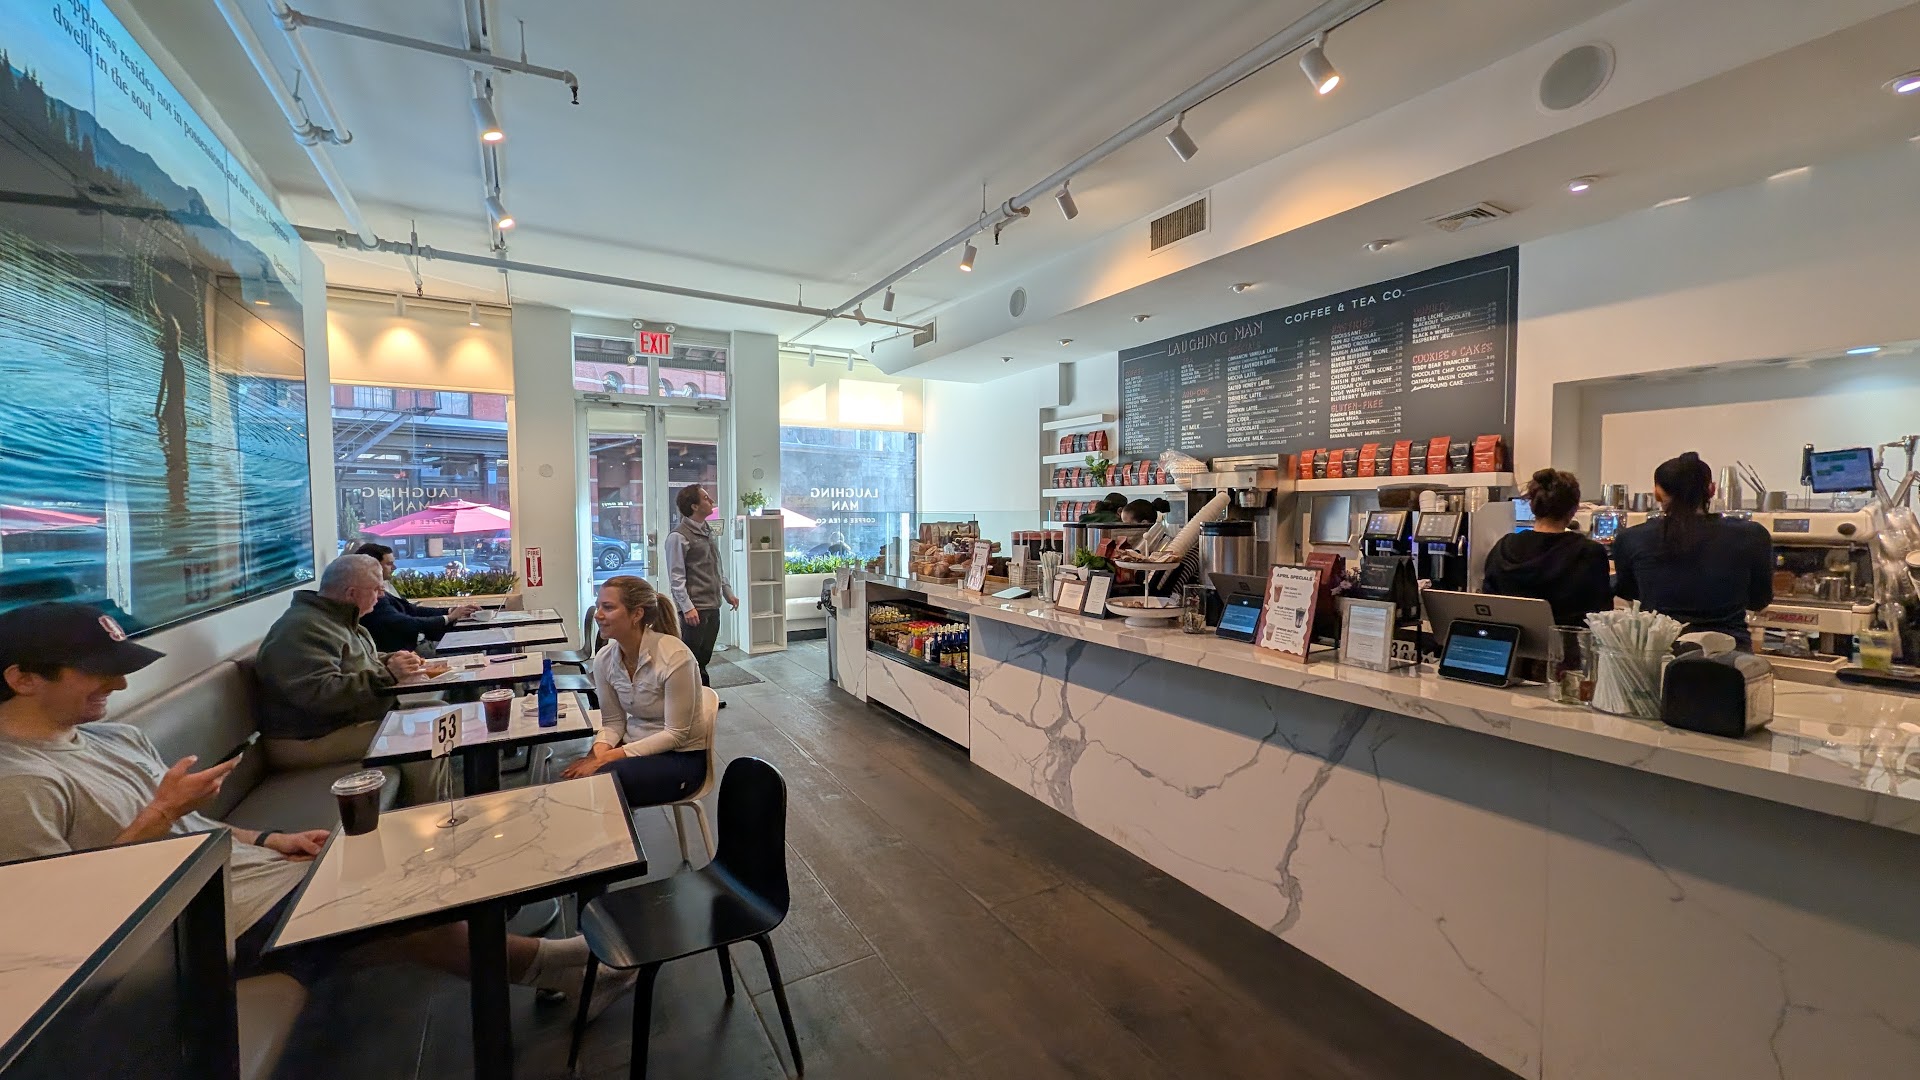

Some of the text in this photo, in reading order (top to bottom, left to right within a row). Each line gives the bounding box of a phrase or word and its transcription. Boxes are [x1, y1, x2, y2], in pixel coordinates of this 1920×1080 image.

[53, 4, 152, 120] dwells in the soul
[119, 49, 155, 97] resides
[156, 90, 173, 116] not
[174, 104, 183, 127] in
[226, 168, 239, 188] and
[1285, 289, 1406, 325] COFFEE & TEA CO.
[1413, 311, 1471, 328] BLACKOUT CHOCOLATE
[1428, 312, 1443, 320] LECHE
[1168, 321, 1263, 357] LAUGHING MAN
[1331, 330, 1361, 340] CROISSANT
[1351, 332, 1376, 341] CHOCOLAT
[1413, 335, 1439, 344] RASPBERRY
[640, 331, 671, 355] EXIT
[1332, 337, 1380, 351] ALMOND CROISSANT
[1228, 353, 1248, 361] CINNAMON
[1412, 350, 1450, 364] COOKIES
[1460, 342, 1493, 356] CAKES
[1242, 362, 1263, 370] LAVENDER
[1331, 360, 1356, 368] BLUEBERRY
[1443, 358, 1469, 366] FINANCIER
[1331, 366, 1352, 374] RHUBARB
[1412, 370, 1440, 378] CHOCOLATE
[1331, 383, 1354, 391] CHEDDAR
[1331, 393, 1358, 402] BLUEBERRY
[1361, 390, 1381, 398] MUFFIN
[1331, 399, 1383, 412] GLUTEN-FREE
[1290, 574, 1313, 582] SPECIALS
[438, 714, 456, 744] 53
